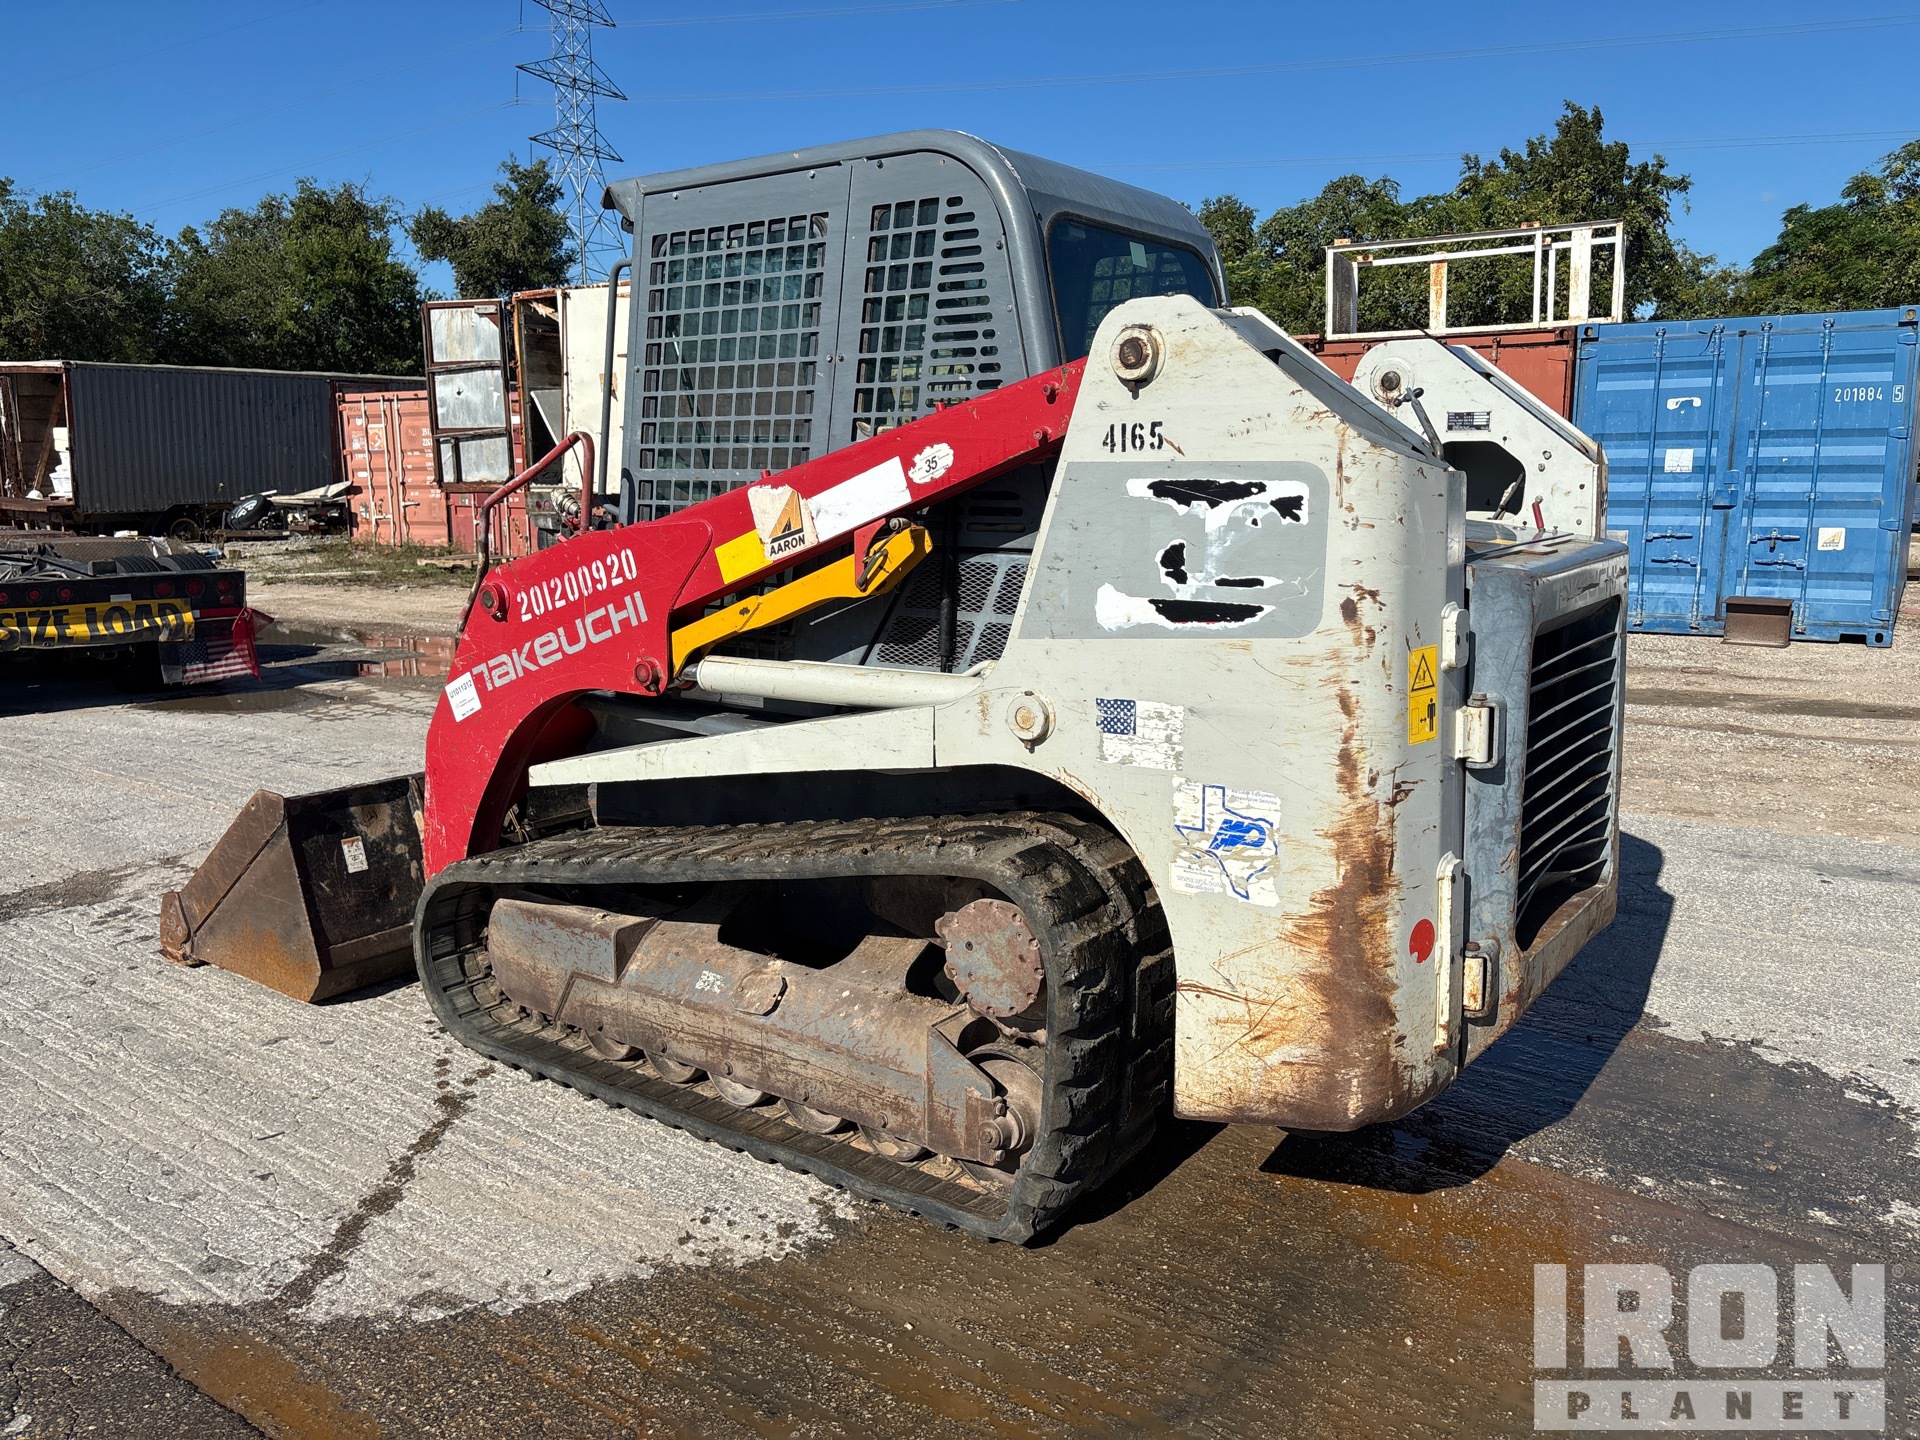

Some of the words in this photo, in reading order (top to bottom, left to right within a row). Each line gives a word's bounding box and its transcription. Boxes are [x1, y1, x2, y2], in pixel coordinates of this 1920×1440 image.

[1834, 386, 1883, 403] 201884
[1102, 421, 1164, 453] 4165
[925, 455, 938, 473] 35
[769, 534, 806, 556] AARON
[516, 548, 638, 622] 201200920
[85, 602, 185, 643] LOAD
